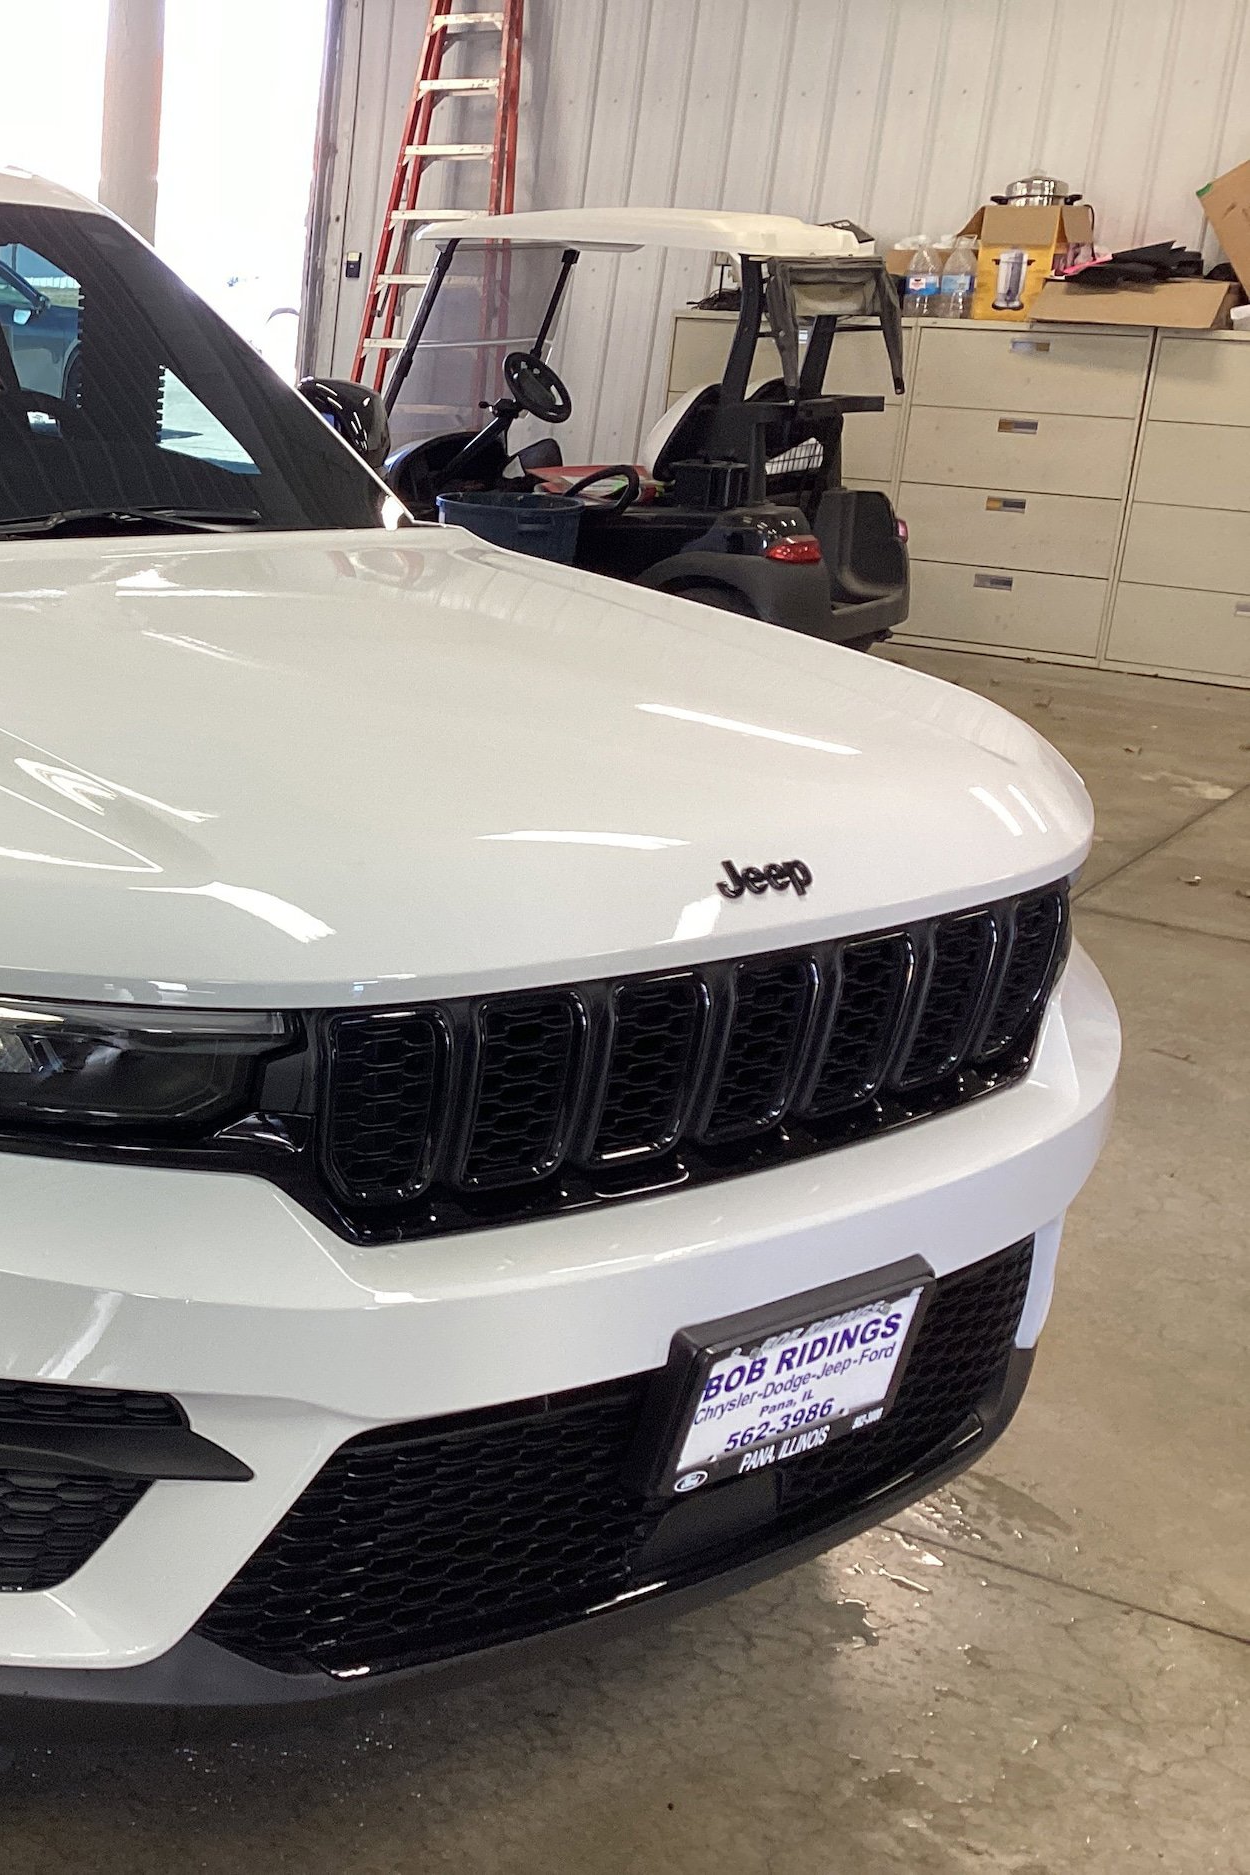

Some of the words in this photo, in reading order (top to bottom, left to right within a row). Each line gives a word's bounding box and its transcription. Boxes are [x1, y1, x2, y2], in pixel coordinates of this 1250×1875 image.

[716, 859, 813, 899] Jeep
[702, 1357, 768, 1403] BOB
[775, 1313, 902, 1375] RIDINGS
[759, 1399, 797, 1417] Pana,
[802, 1389, 814, 1402] IL
[725, 1398, 834, 1452] 562-3986
[777, 1424, 831, 1460] ILLINOIS
